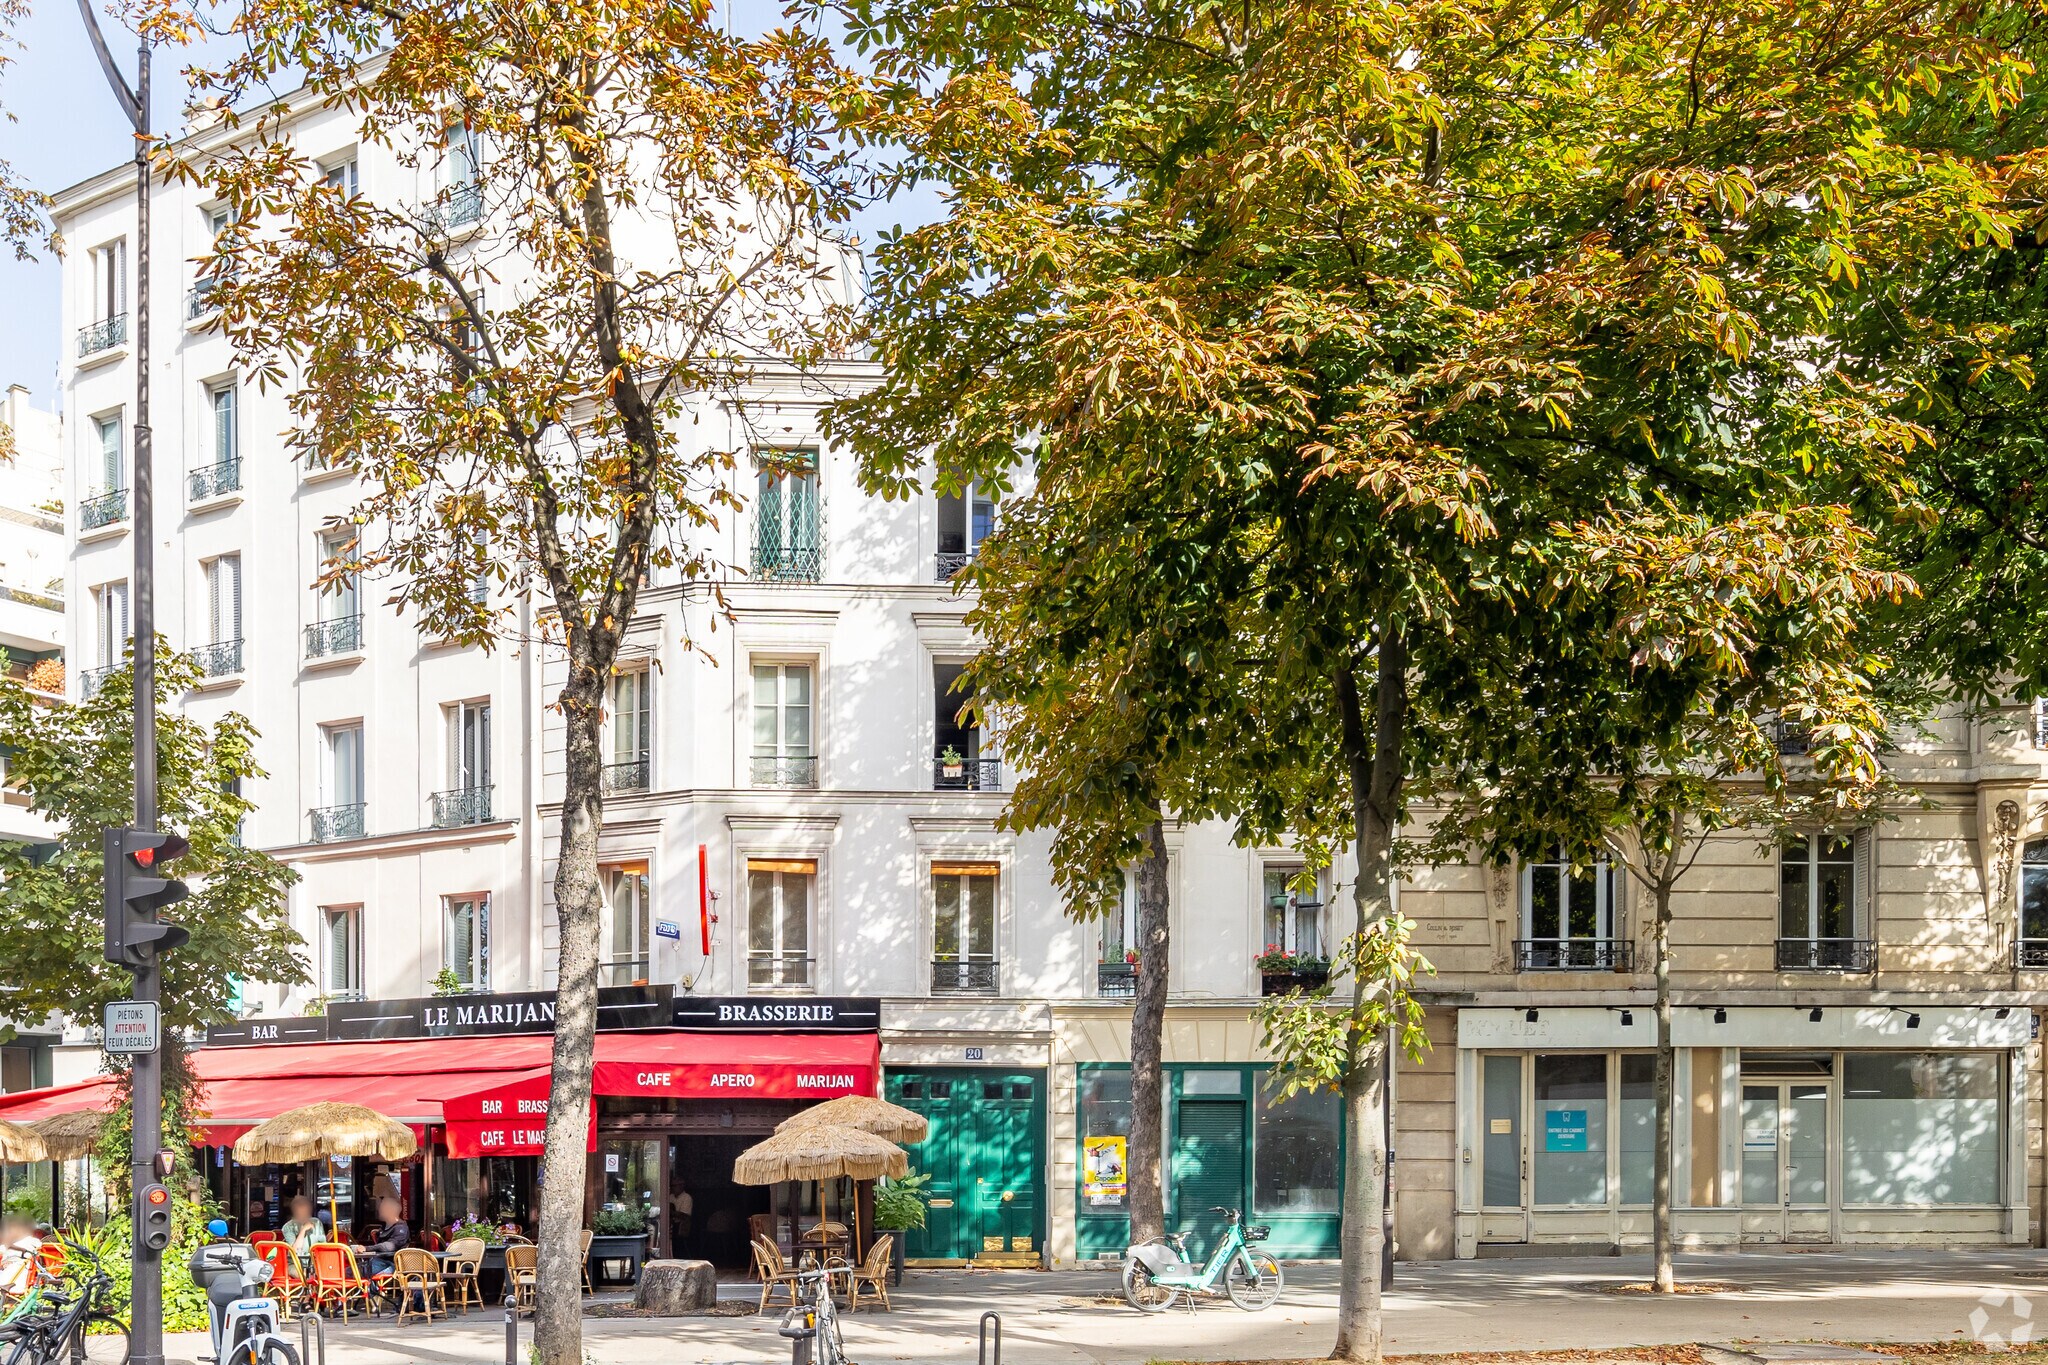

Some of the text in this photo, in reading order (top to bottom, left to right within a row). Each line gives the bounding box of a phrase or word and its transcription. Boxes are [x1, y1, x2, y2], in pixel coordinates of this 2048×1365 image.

[118, 1008, 143, 1020] PIÉTONS
[424, 1002, 556, 1026] LE MARIJAN
[719, 1005, 833, 1021] BRASSERIE
[114, 1023, 147, 1033] ATTENTION
[252, 1025, 278, 1039] BAR
[109, 1035, 152, 1047] FEUX DÉCALÉS
[967, 1049, 981, 1059] 20
[637, 1073, 854, 1088] CAFE APERO MARIJAN
[482, 1100, 548, 1113] BAR BRASS
[481, 1131, 546, 1146] CAFE LE MAR
[1210, 1249, 1229, 1273] TIER
